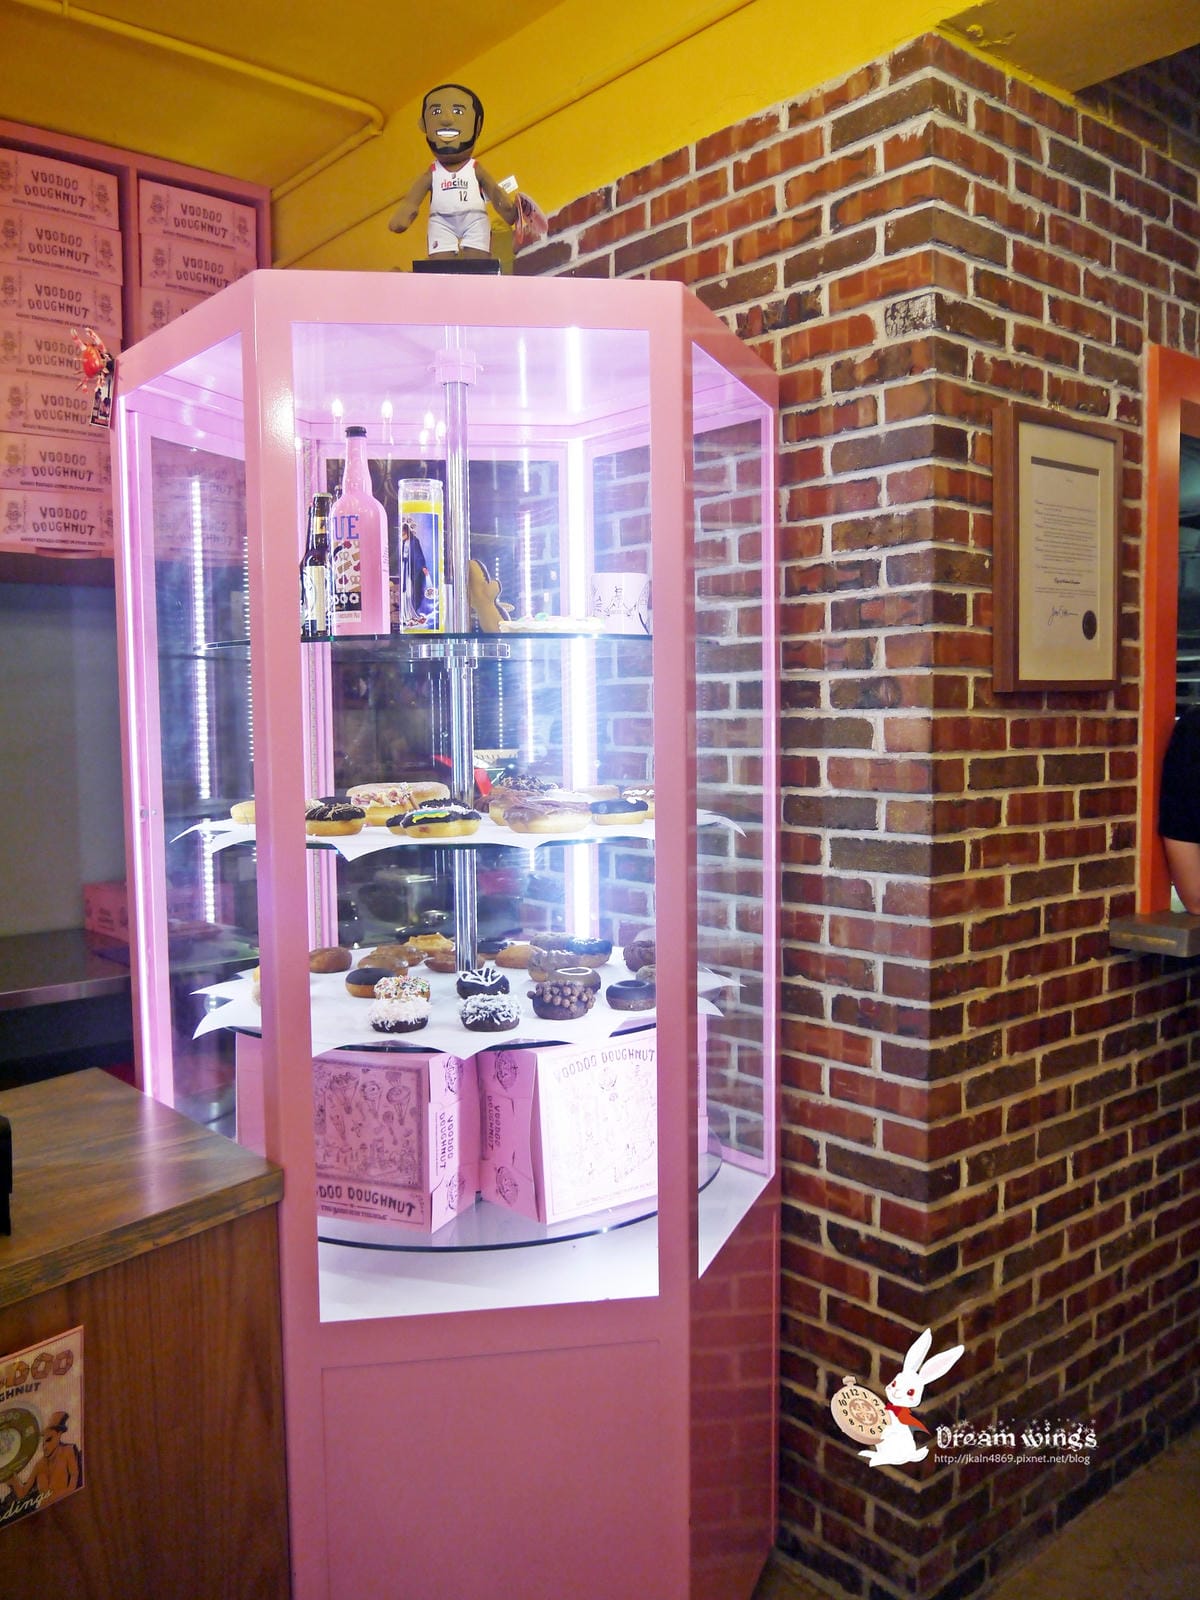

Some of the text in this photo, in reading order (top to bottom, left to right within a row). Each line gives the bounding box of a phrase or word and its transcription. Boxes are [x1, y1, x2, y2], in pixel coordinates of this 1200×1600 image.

[31, 169, 79, 191] VOODOO
[24, 184, 87, 208] DOUGHNUT
[459, 190, 468, 202] 12
[180, 203, 223, 223] VOODOO
[174, 216, 229, 239] DOUGHNUT
[35, 227, 82, 248] VOODOO
[28, 242, 90, 264] DOUGHNUT
[182, 256, 224, 275] VOODOO
[35, 283, 82, 303] VOODOO
[28, 298, 90, 319] DOUGHNUT
[27, 354, 82, 370] DOUGHNU
[41, 393, 88, 410] VOODOO
[39, 450, 87, 466] VOODOO
[32, 465, 94, 482] DOUGHNUT
[39, 506, 88, 521] VOODOO
[32, 521, 96, 537] DOUGHNUT
[601, 1048, 655, 1064] DOUGHNUT
[347, 1186, 416, 1217] DOUGHNUT
